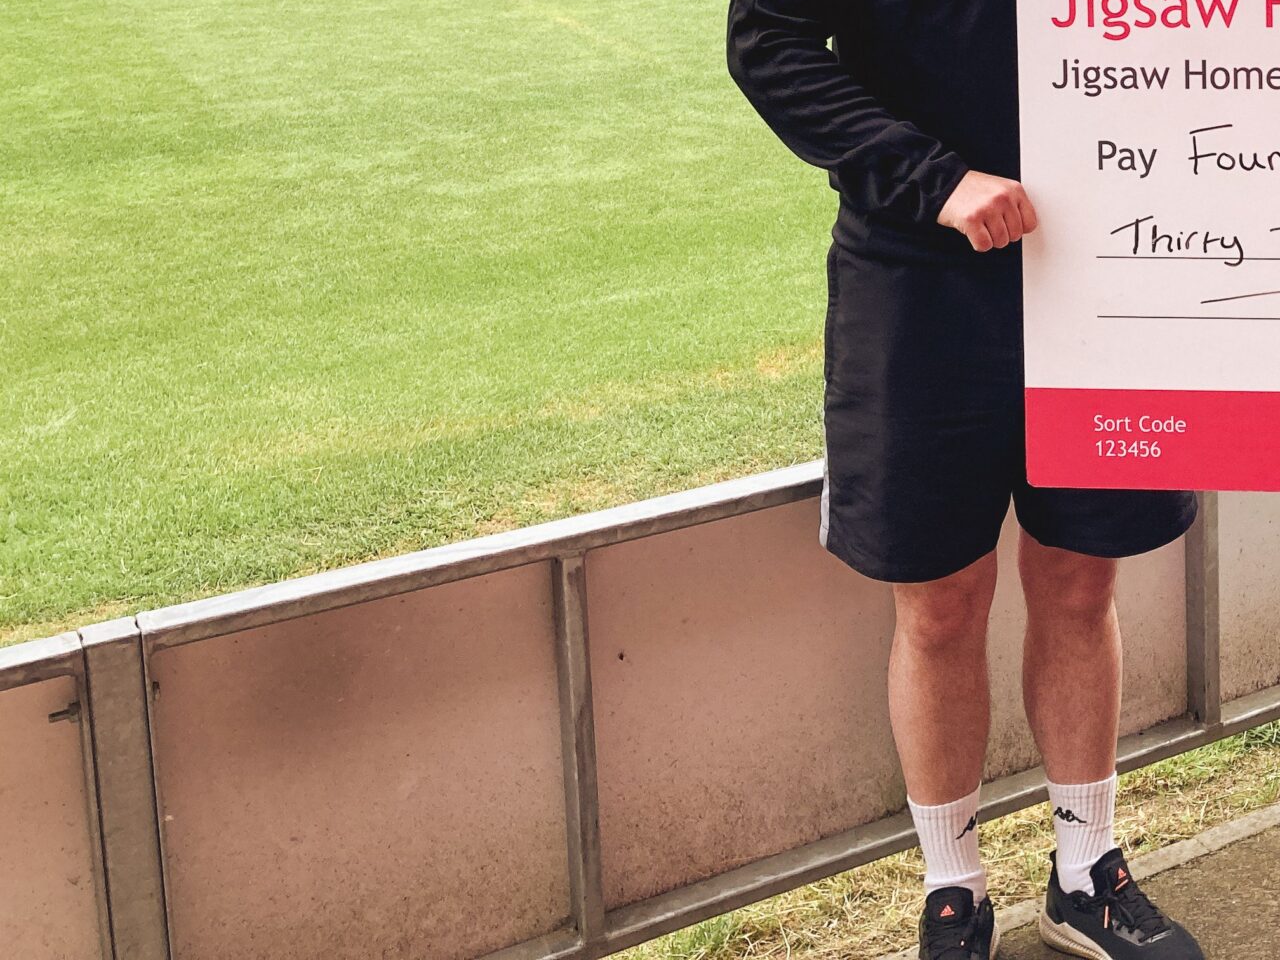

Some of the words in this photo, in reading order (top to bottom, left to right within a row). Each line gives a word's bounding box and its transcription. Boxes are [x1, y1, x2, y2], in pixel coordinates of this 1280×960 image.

[1052, 59, 1170, 98] Jigsaw
[1098, 140, 1158, 178] Pay
[1111, 216, 1244, 266] Thirty
[1093, 415, 1132, 432] Sort
[1138, 416, 1187, 433] Code
[1095, 440, 1161, 458] 123456
